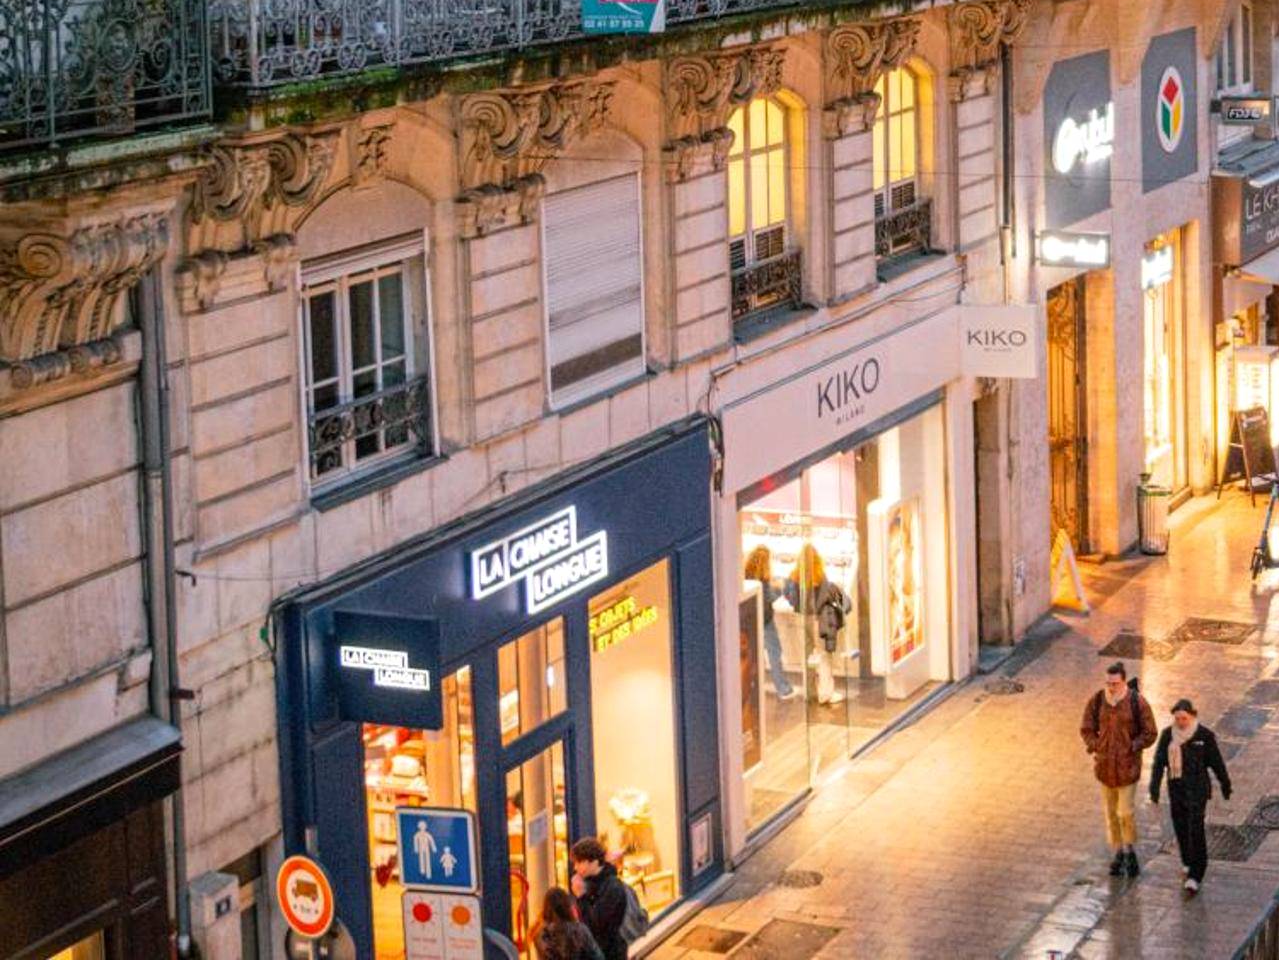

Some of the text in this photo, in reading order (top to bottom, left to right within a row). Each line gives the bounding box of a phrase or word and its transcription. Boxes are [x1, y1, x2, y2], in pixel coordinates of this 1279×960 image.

[1246, 192, 1261, 220] LE
[967, 329, 1027, 348] KIKO
[817, 357, 879, 419] KIKO
[480, 552, 504, 586] LA
[534, 544, 602, 601] LONGUE
[346, 650, 360, 664] LA
